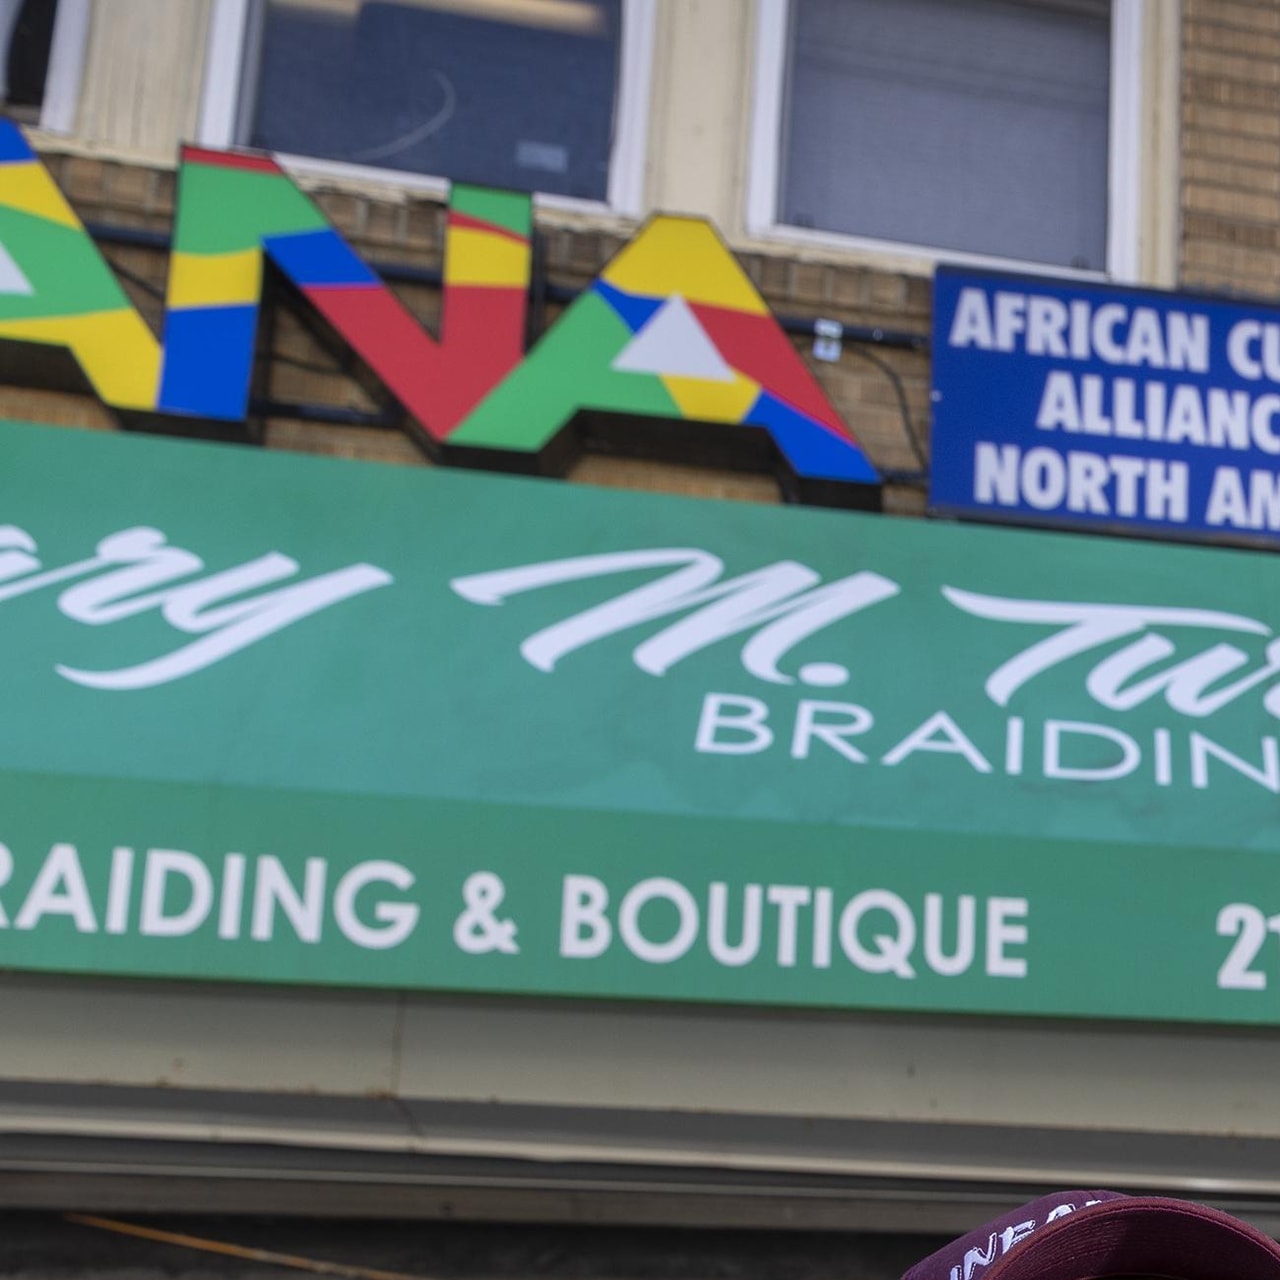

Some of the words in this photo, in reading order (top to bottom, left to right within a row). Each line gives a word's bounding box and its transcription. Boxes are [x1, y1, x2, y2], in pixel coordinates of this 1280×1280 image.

[949, 286, 1210, 374] AFRICAN
[972, 441, 1190, 523] NORTH
[449, 546, 900, 686] M.
[452, 869, 521, 955] &
[558, 873, 1030, 979] BOUTIQUE
